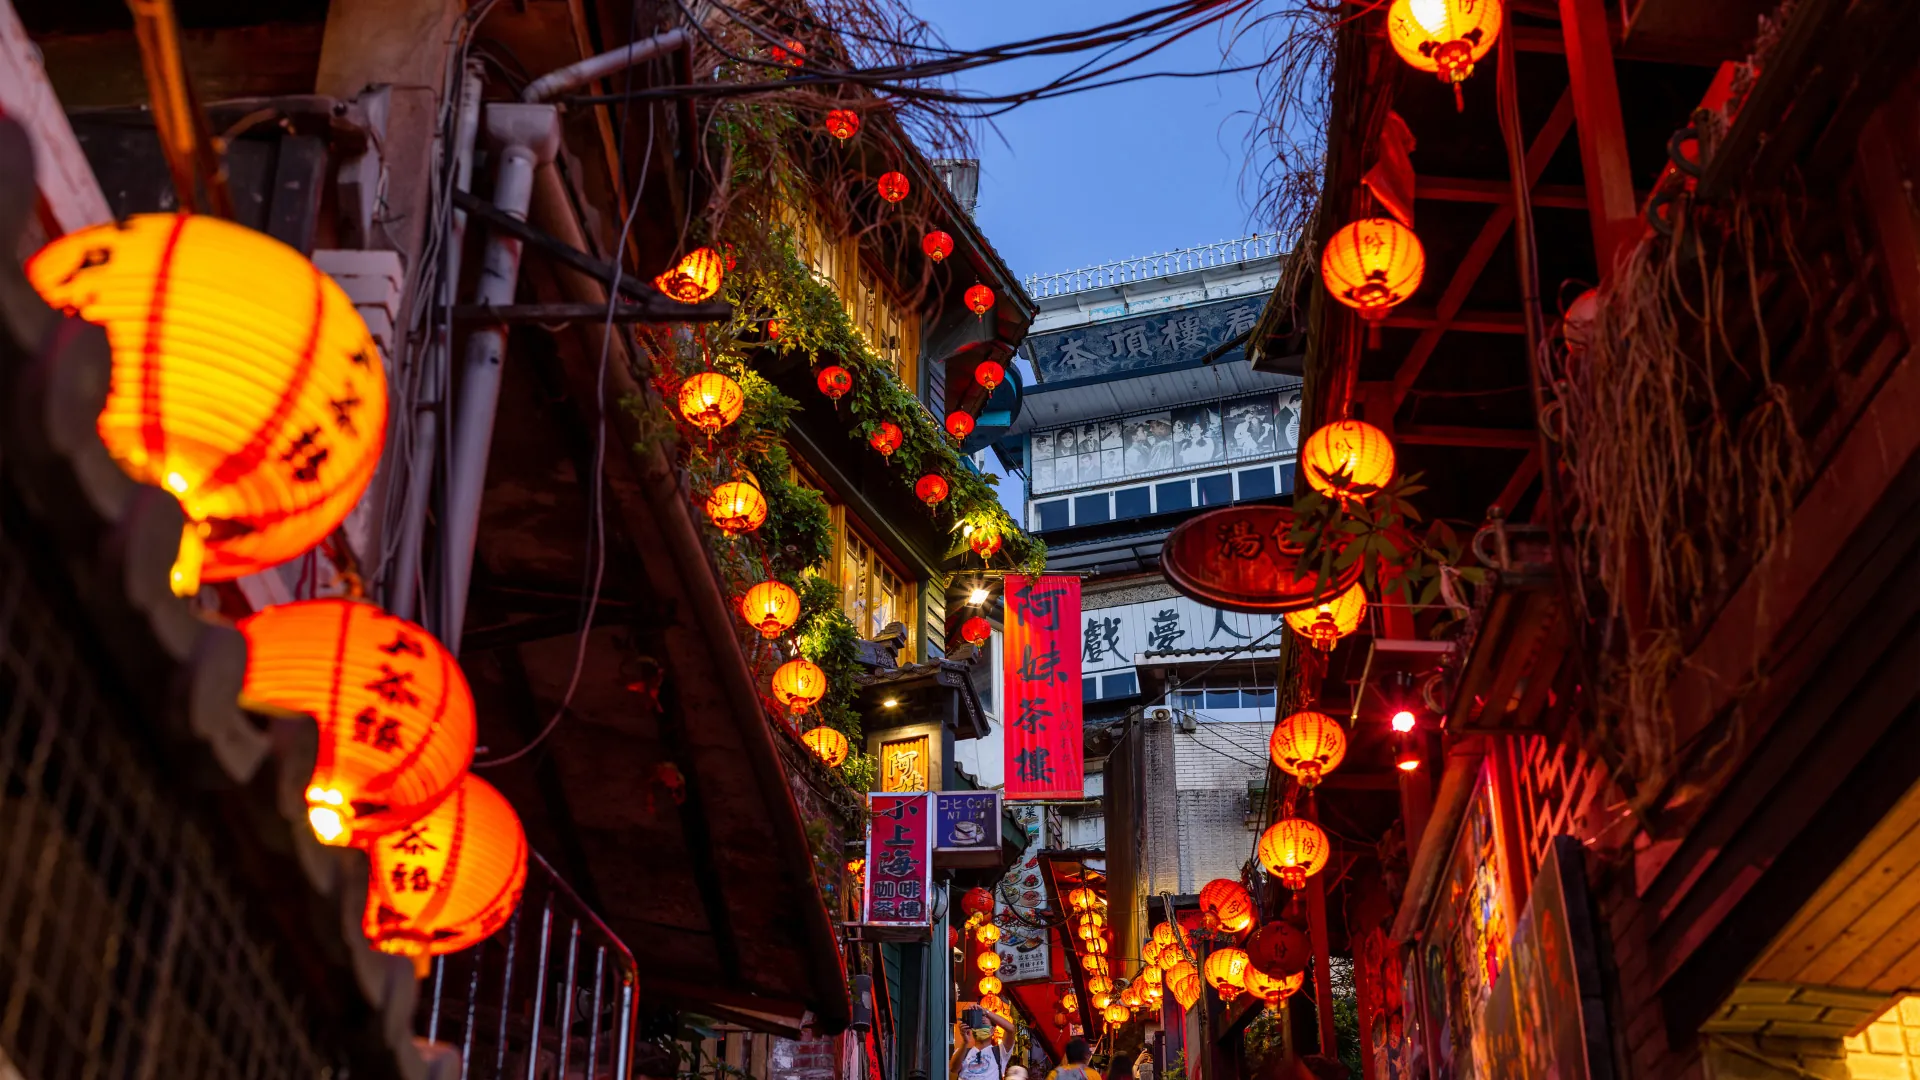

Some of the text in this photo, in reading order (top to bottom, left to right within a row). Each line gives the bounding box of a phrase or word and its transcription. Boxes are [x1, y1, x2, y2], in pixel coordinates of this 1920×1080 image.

[1081, 608, 1282, 663] 戲夢人
[1014, 585, 1068, 784] 阿妹茶樓
[877, 800, 920, 878] 小上海
[873, 900, 921, 918] 茶樓
[874, 881, 921, 898] 咖啡
